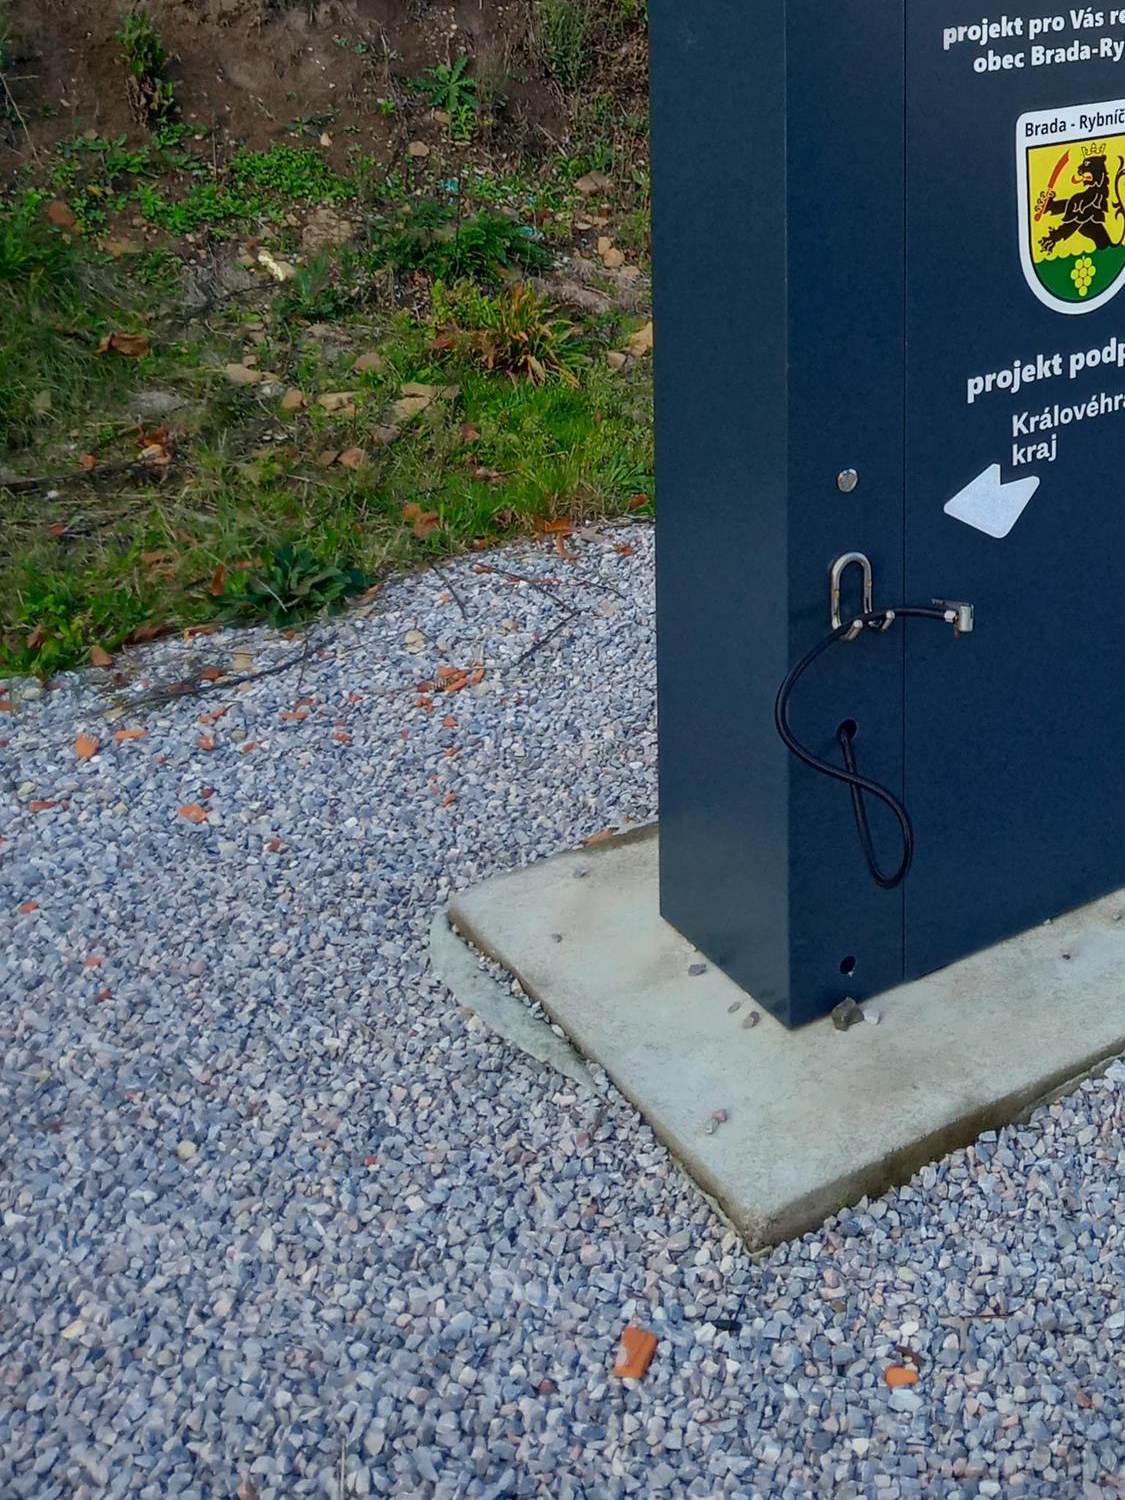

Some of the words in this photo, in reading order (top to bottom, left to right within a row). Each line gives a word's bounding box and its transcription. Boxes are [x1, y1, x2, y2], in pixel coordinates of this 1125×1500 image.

[943, 15, 1023, 50] projekt
[1029, 16, 1065, 40] pro
[1070, 7, 1104, 30] Vás
[973, 51, 1025, 73] obec
[1025, 117, 1067, 137] Brada
[967, 353, 1062, 403] projekt
[1012, 434, 1057, 466] kraj
